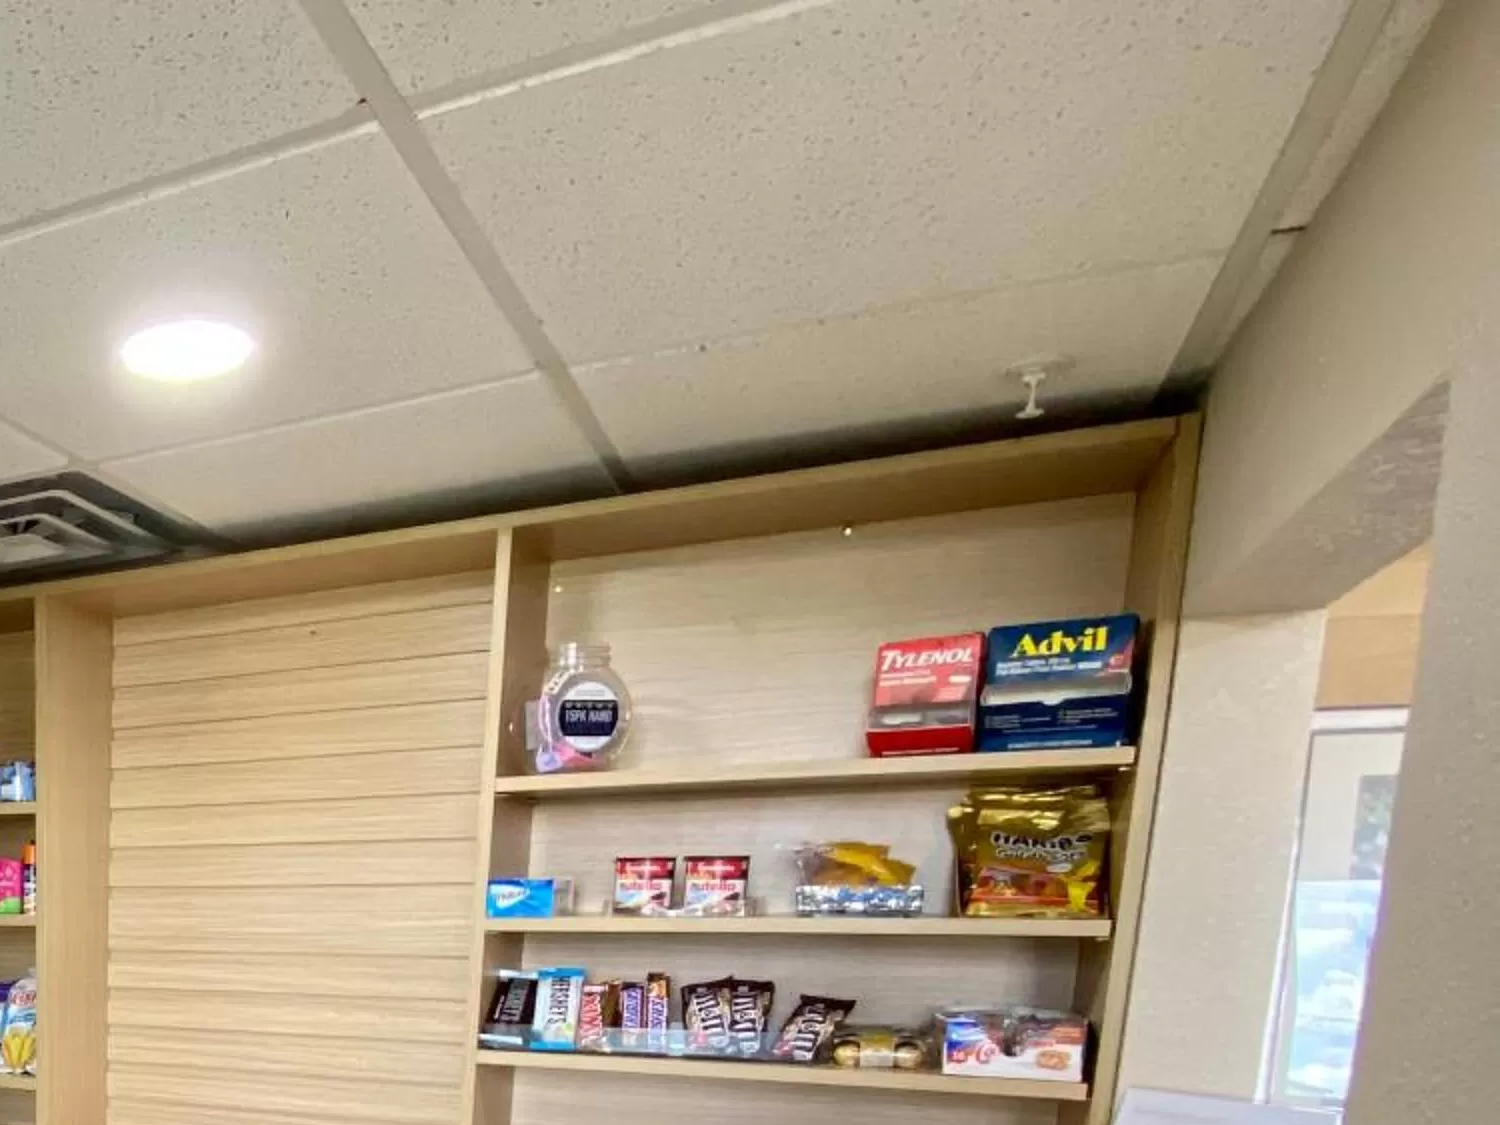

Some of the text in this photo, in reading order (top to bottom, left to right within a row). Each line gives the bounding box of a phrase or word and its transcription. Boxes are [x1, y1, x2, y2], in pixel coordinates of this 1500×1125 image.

[1010, 626, 1108, 658] Advil
[880, 647, 973, 672] TYLENOL
[548, 974, 572, 1025] HERSHEY'S
